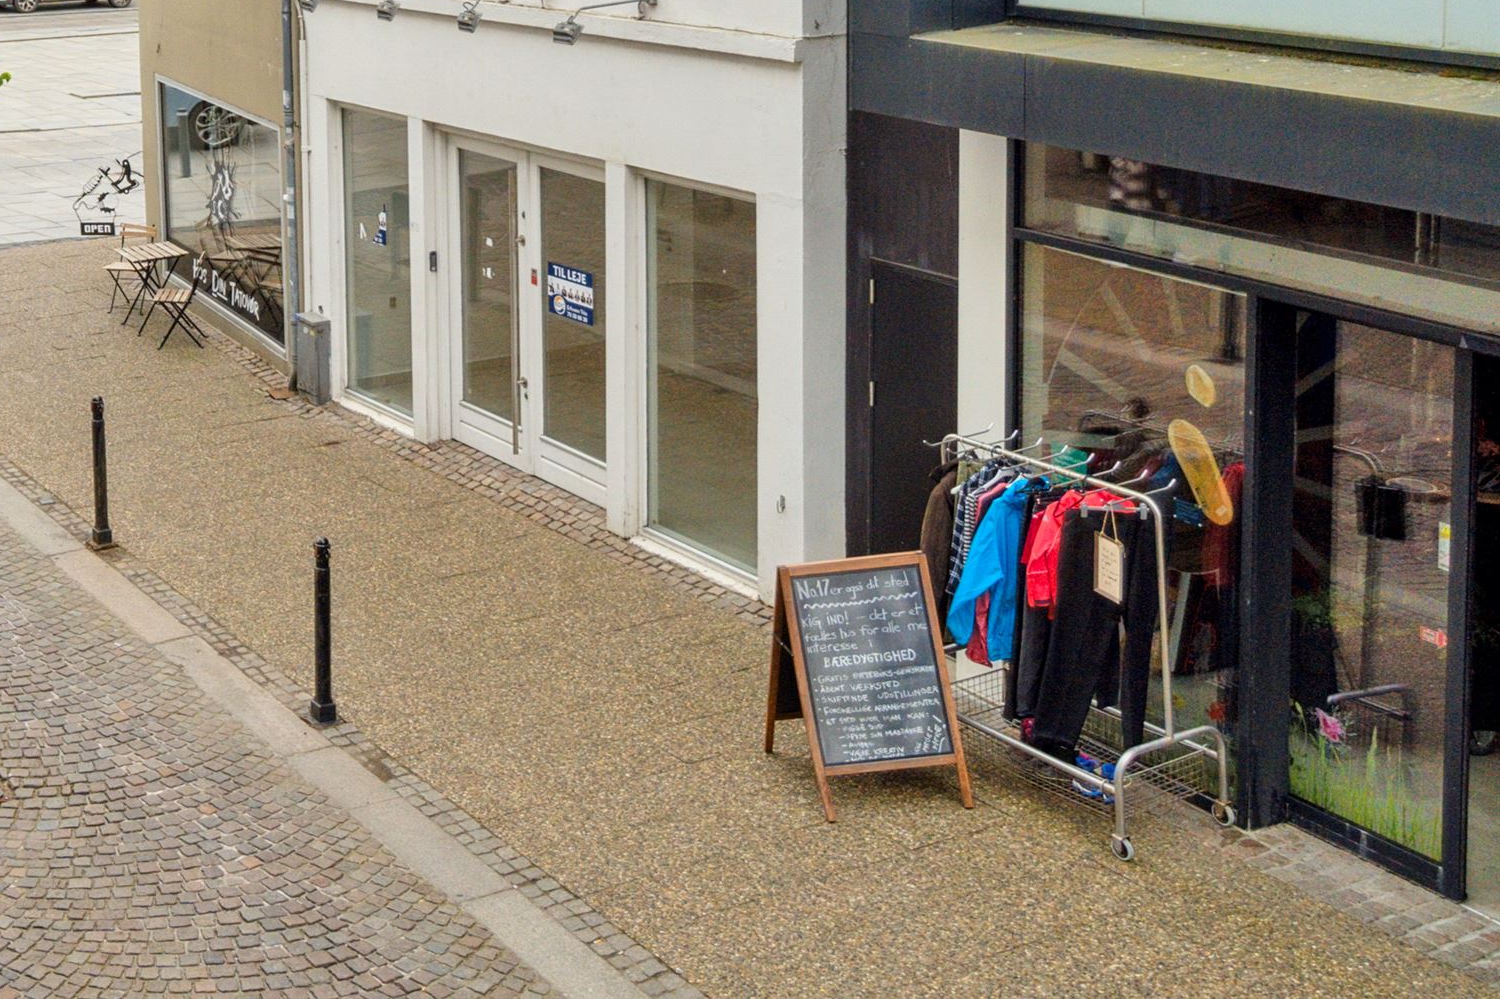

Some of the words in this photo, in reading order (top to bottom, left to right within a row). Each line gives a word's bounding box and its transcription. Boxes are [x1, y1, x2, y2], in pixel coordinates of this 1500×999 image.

[84, 225, 111, 233] OPEN
[552, 265, 566, 279] TIL
[567, 269, 587, 285] LEJE
[212, 270, 227, 298] DIN
[885, 572, 909, 587] sted
[869, 609, 887, 621] det
[807, 641, 858, 653] interesse
[824, 649, 916, 668] BÆREDYGTIGHED
